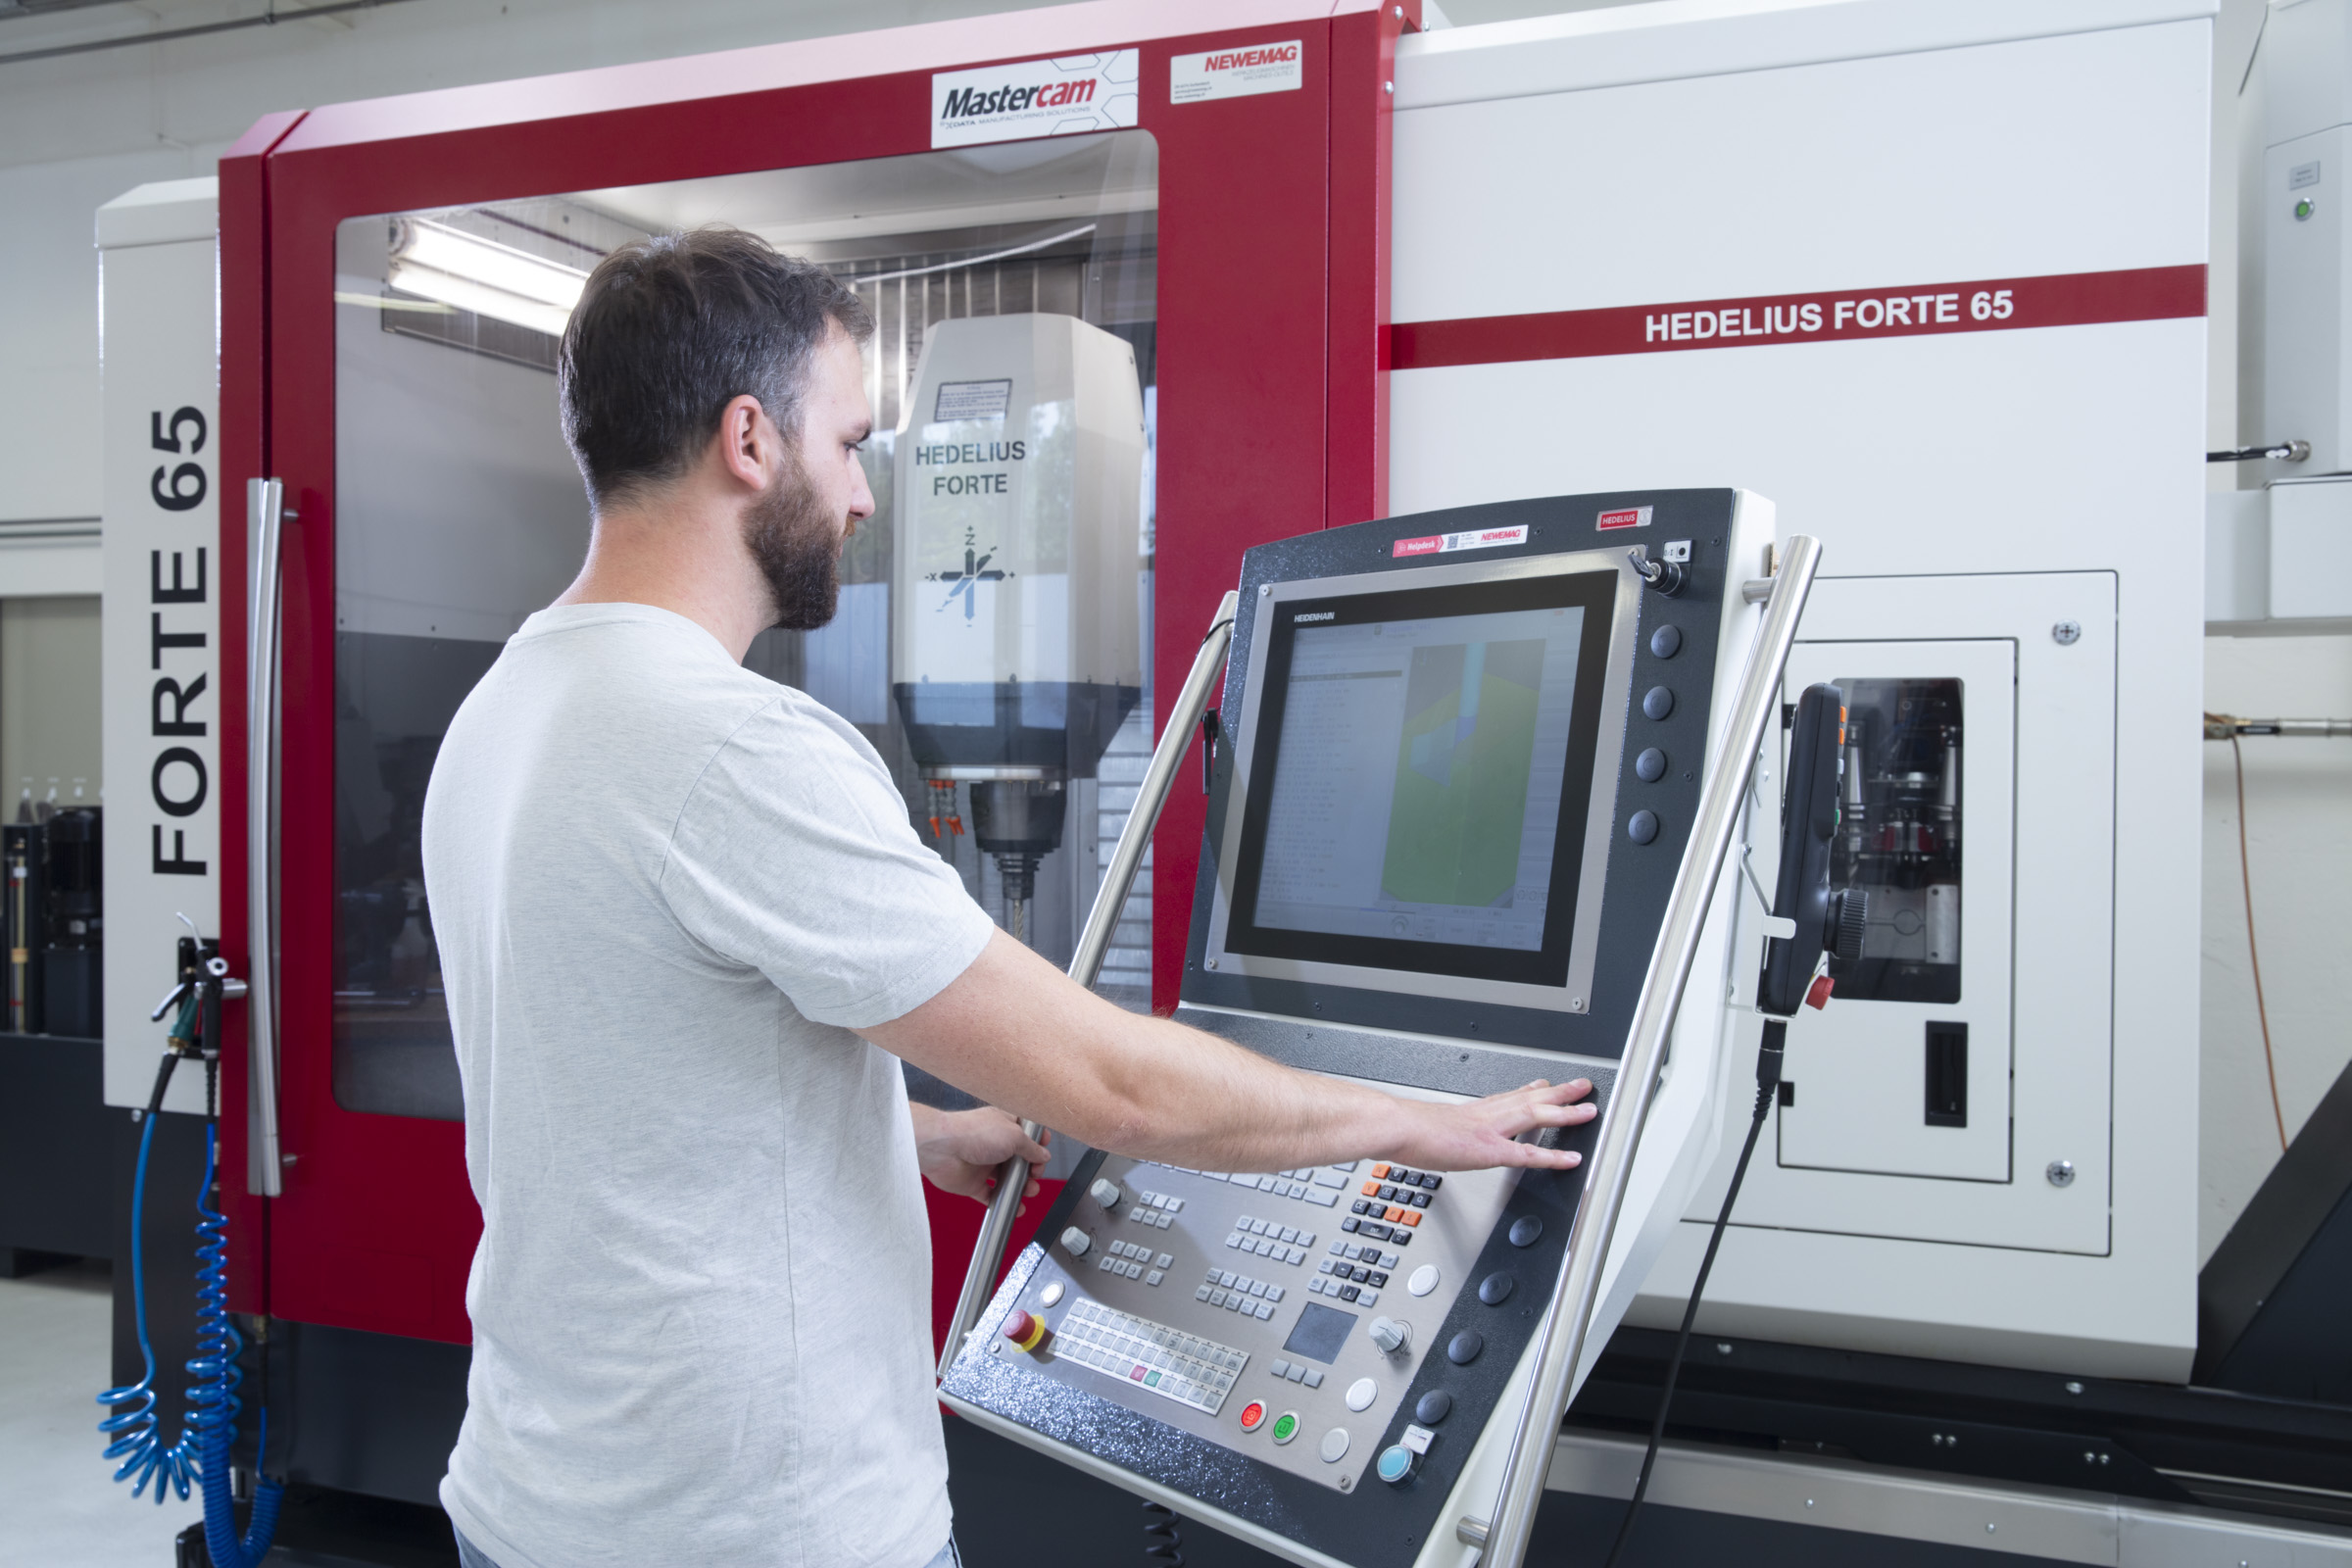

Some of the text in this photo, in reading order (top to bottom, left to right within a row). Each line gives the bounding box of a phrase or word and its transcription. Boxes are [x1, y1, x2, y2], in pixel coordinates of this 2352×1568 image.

[1204, 45, 1298, 73] NEWEMAG
[942, 78, 1097, 119] Mastercam
[979, 112, 1045, 124] MANUFACTURING
[1047, 106, 1091, 117] SOLUTIONS
[1645, 290, 2014, 342] HEDELIUS FORTE 65
[915, 441, 1026, 466] HEDELIUS
[933, 473, 1007, 496] FORTE
[1602, 514, 1636, 525] HEDELIUS
[1407, 540, 1436, 552] Helpdesk
[1481, 529, 1522, 541] NEWEMAG
[1294, 612, 1335, 622] HEIDENHAIN
[151, 406, 208, 876] FORTE 65
